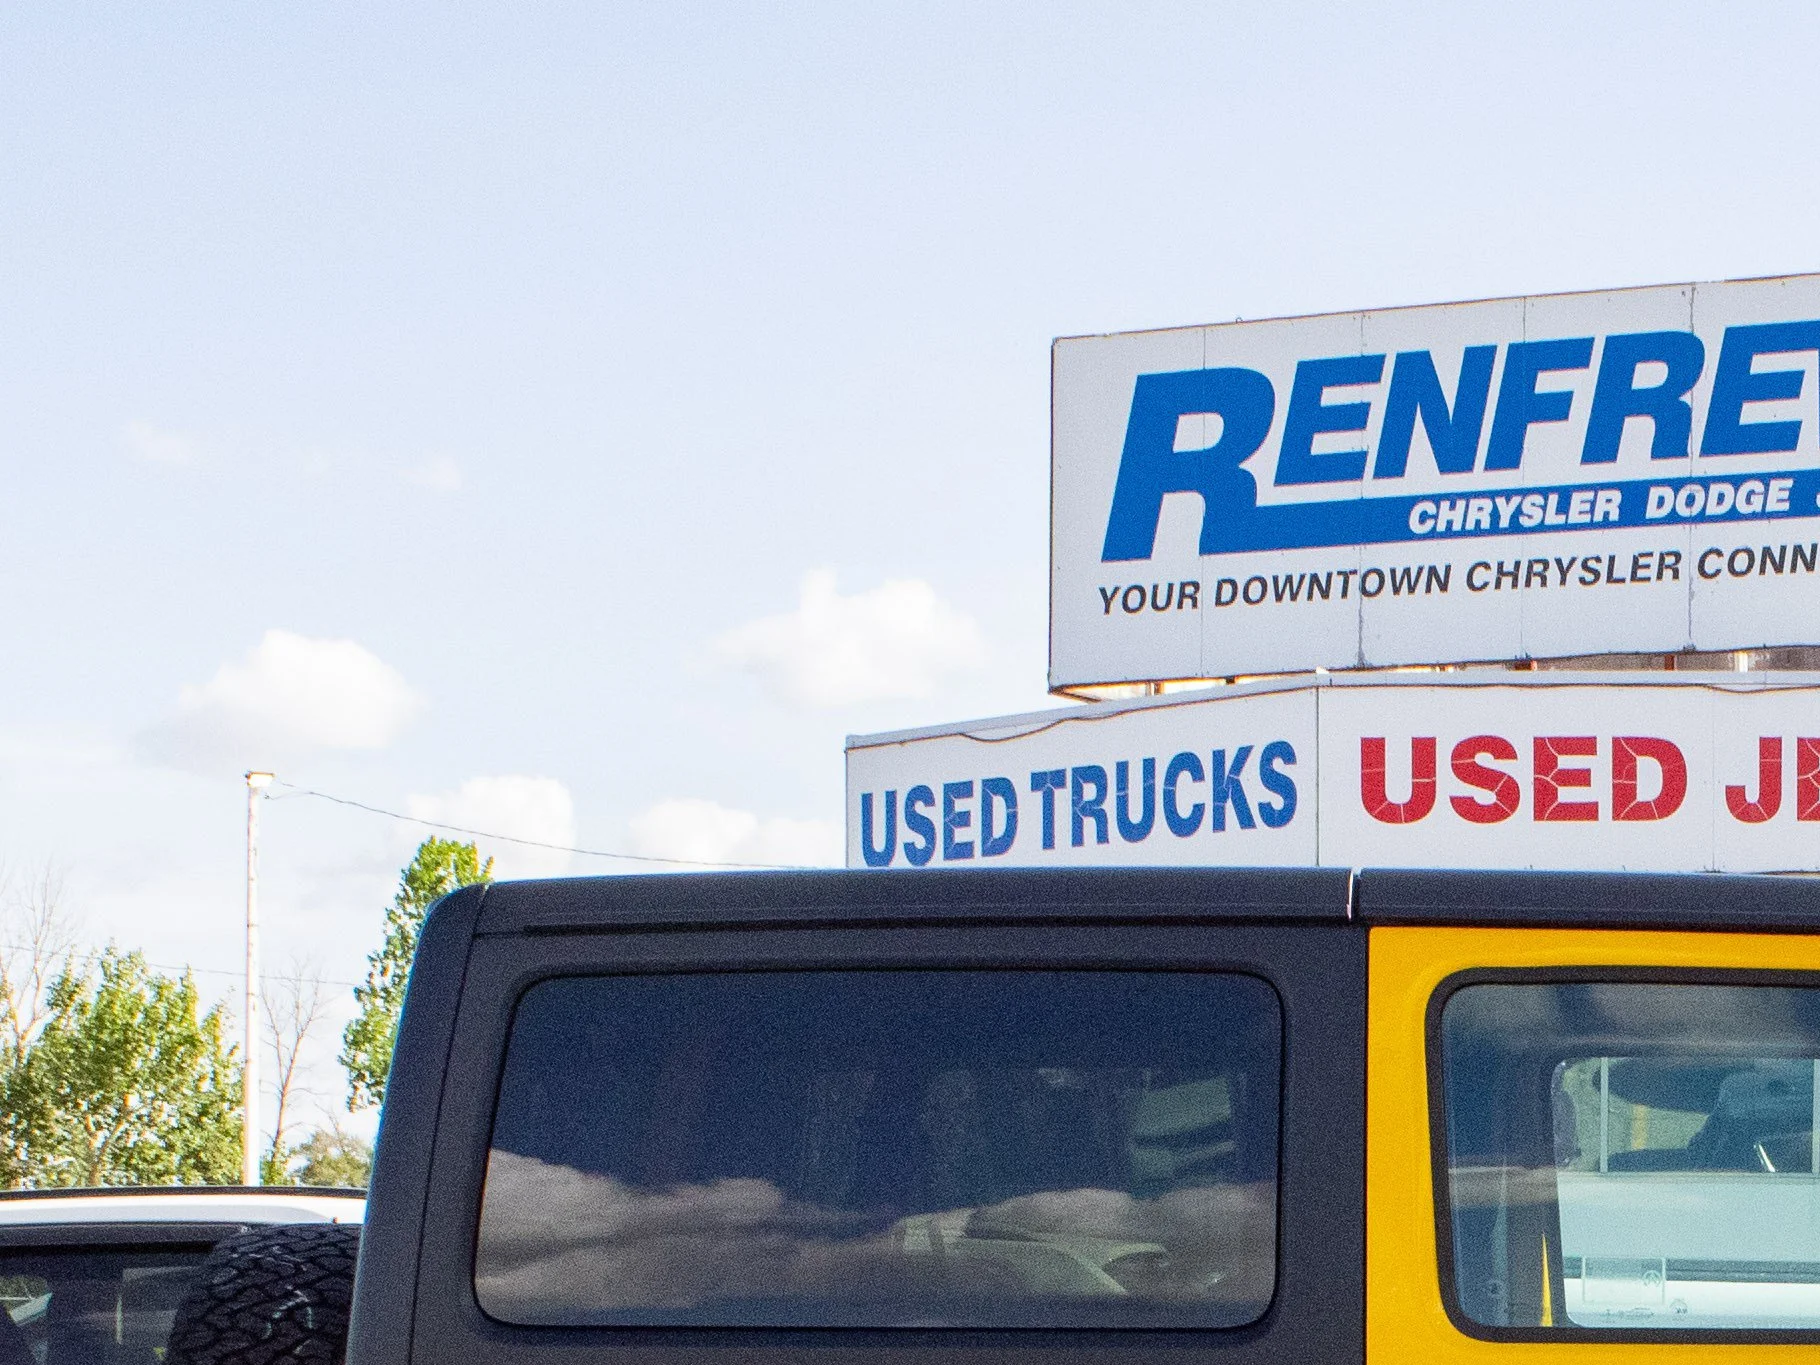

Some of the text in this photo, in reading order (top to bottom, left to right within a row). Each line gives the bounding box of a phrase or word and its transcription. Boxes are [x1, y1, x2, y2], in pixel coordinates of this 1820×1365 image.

[1409, 488, 1622, 535] CHRYSLER
[1645, 478, 1794, 520] DODGE
[1098, 580, 1201, 616] YOUR
[1215, 563, 1453, 608] DOWNTOWN
[1466, 549, 1683, 593] CHRYSLER
[861, 740, 1299, 868] USED TRUCKS
[1360, 735, 1689, 825] USED
